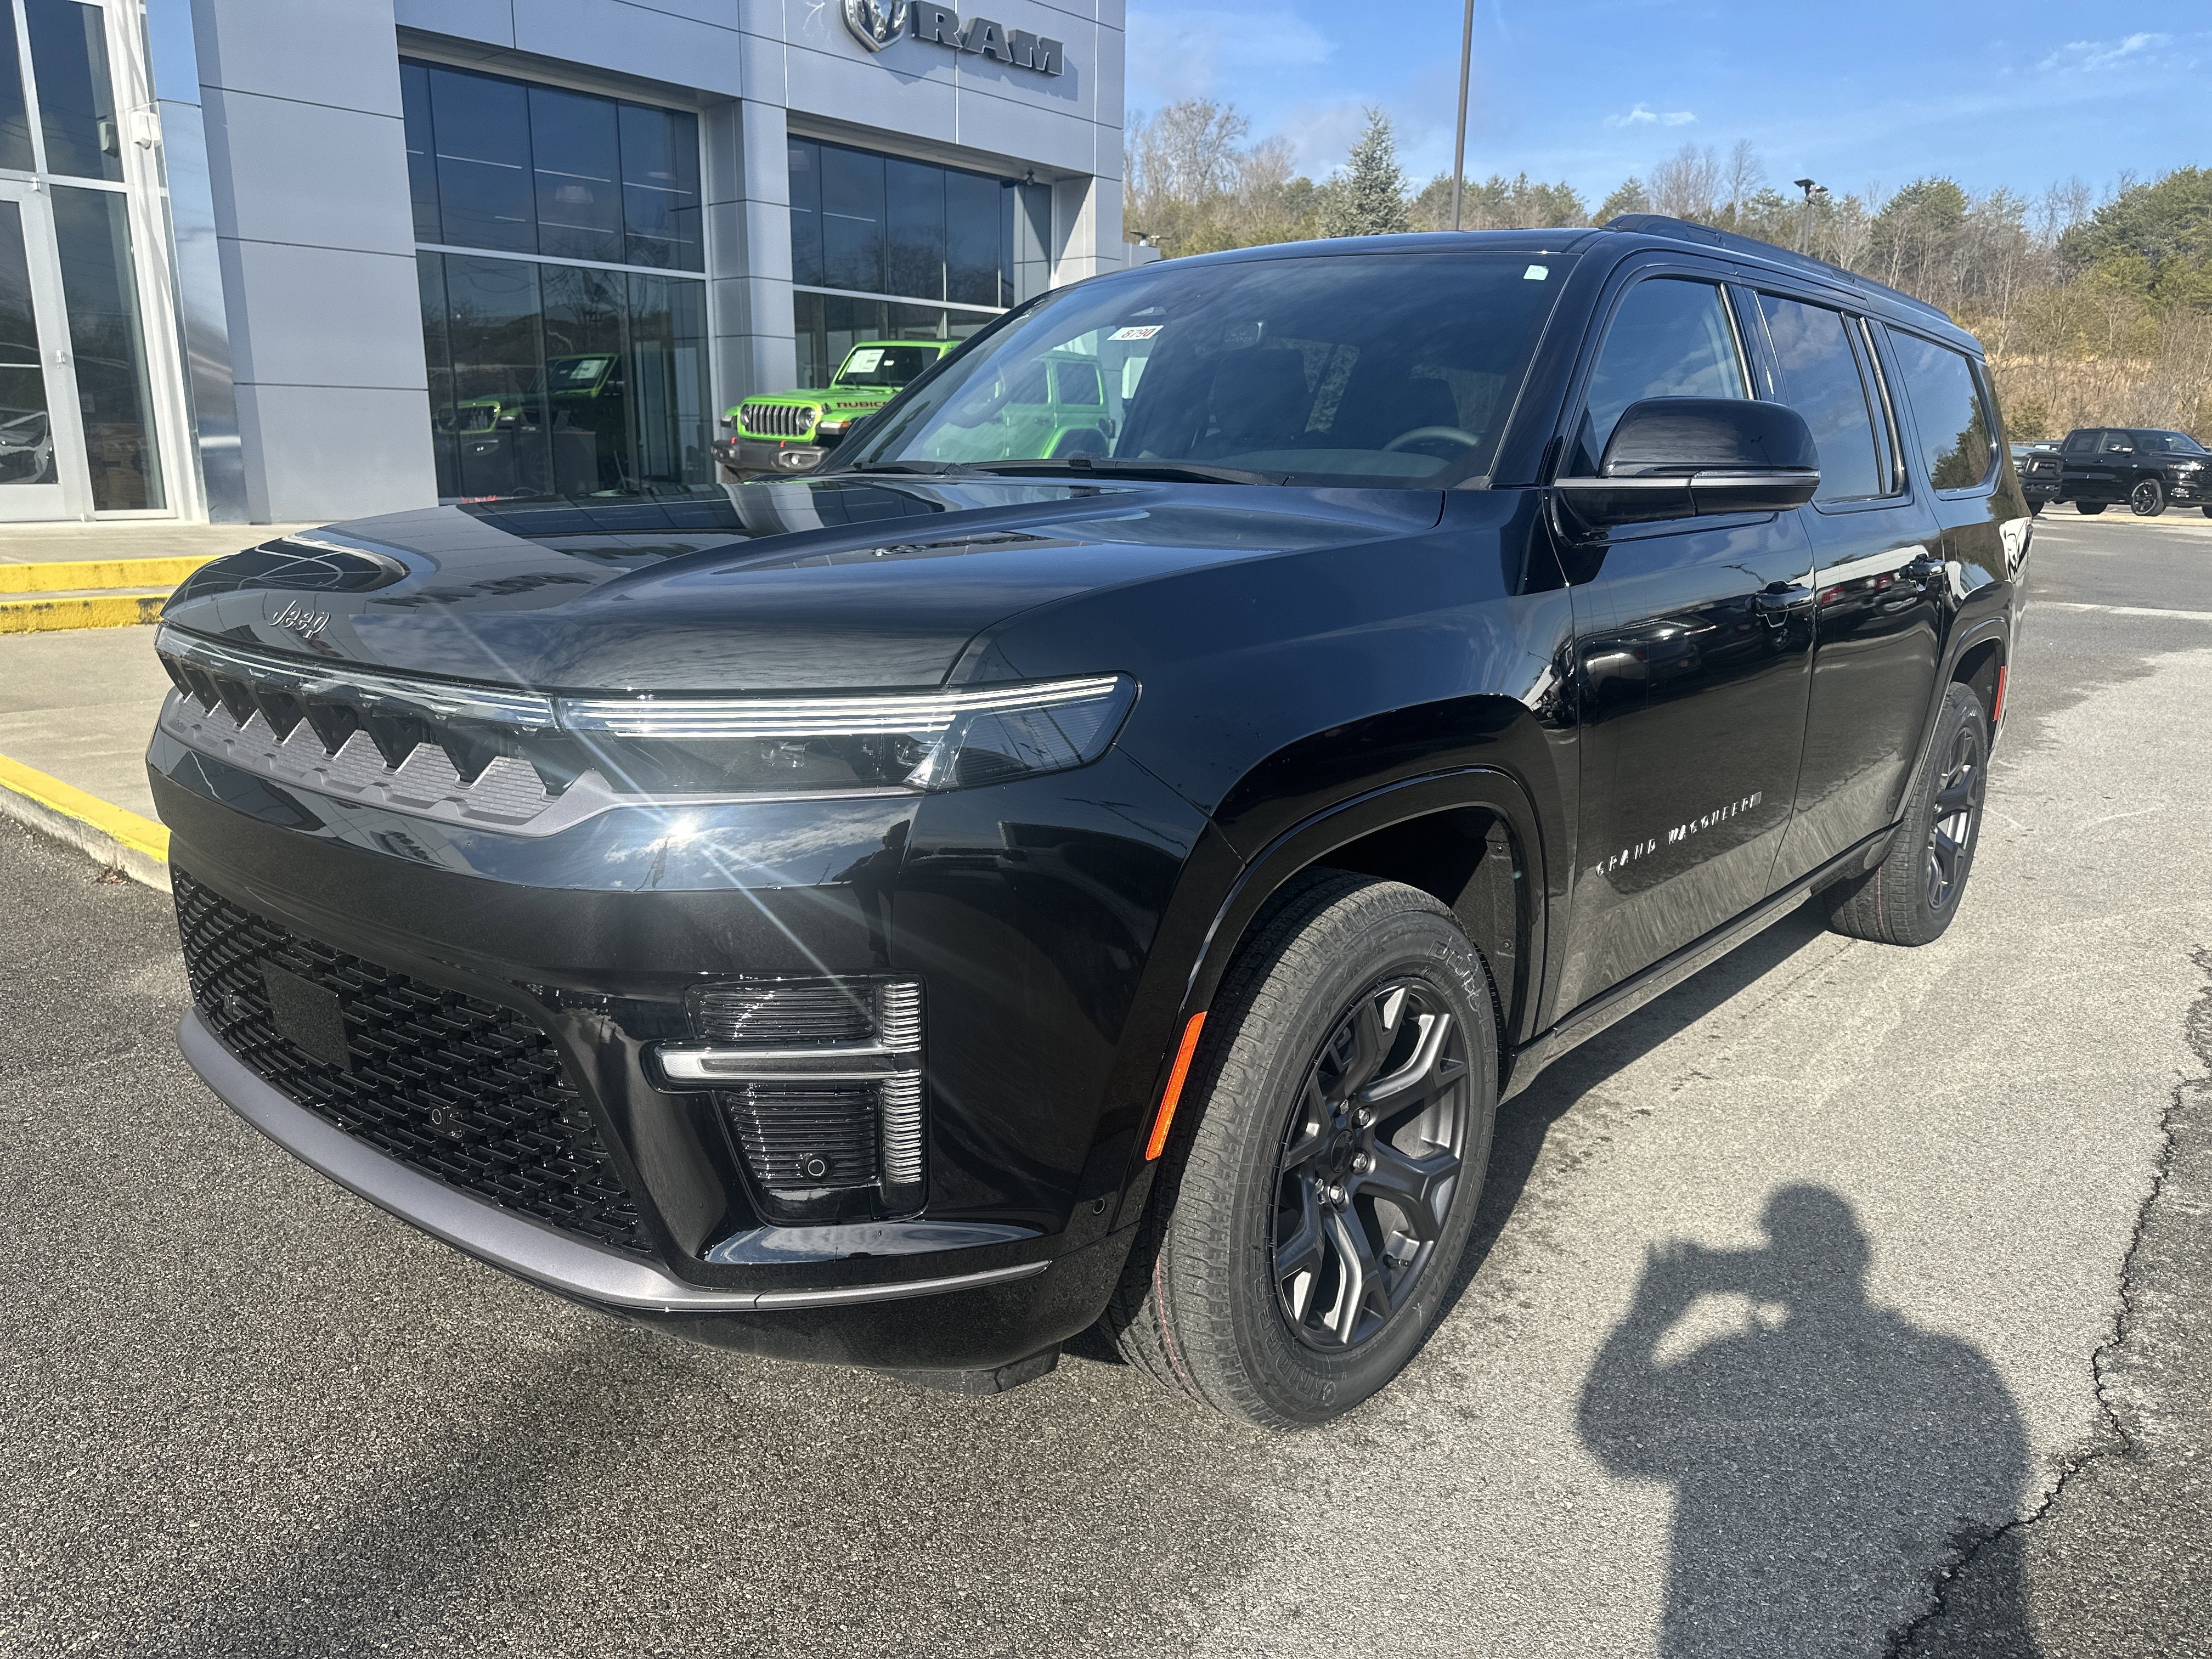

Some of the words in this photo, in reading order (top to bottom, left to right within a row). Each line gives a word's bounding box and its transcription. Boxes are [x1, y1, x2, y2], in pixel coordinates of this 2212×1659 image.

[913, 1, 1064, 76] RAM
[1121, 328, 1156, 338] 8790
[268, 600, 331, 639] Jeep
[1595, 838, 1656, 877] GRAND
[1668, 797, 1749, 845] WAGONEER
[1255, 1139, 1338, 1407] BRIDGESTONE
